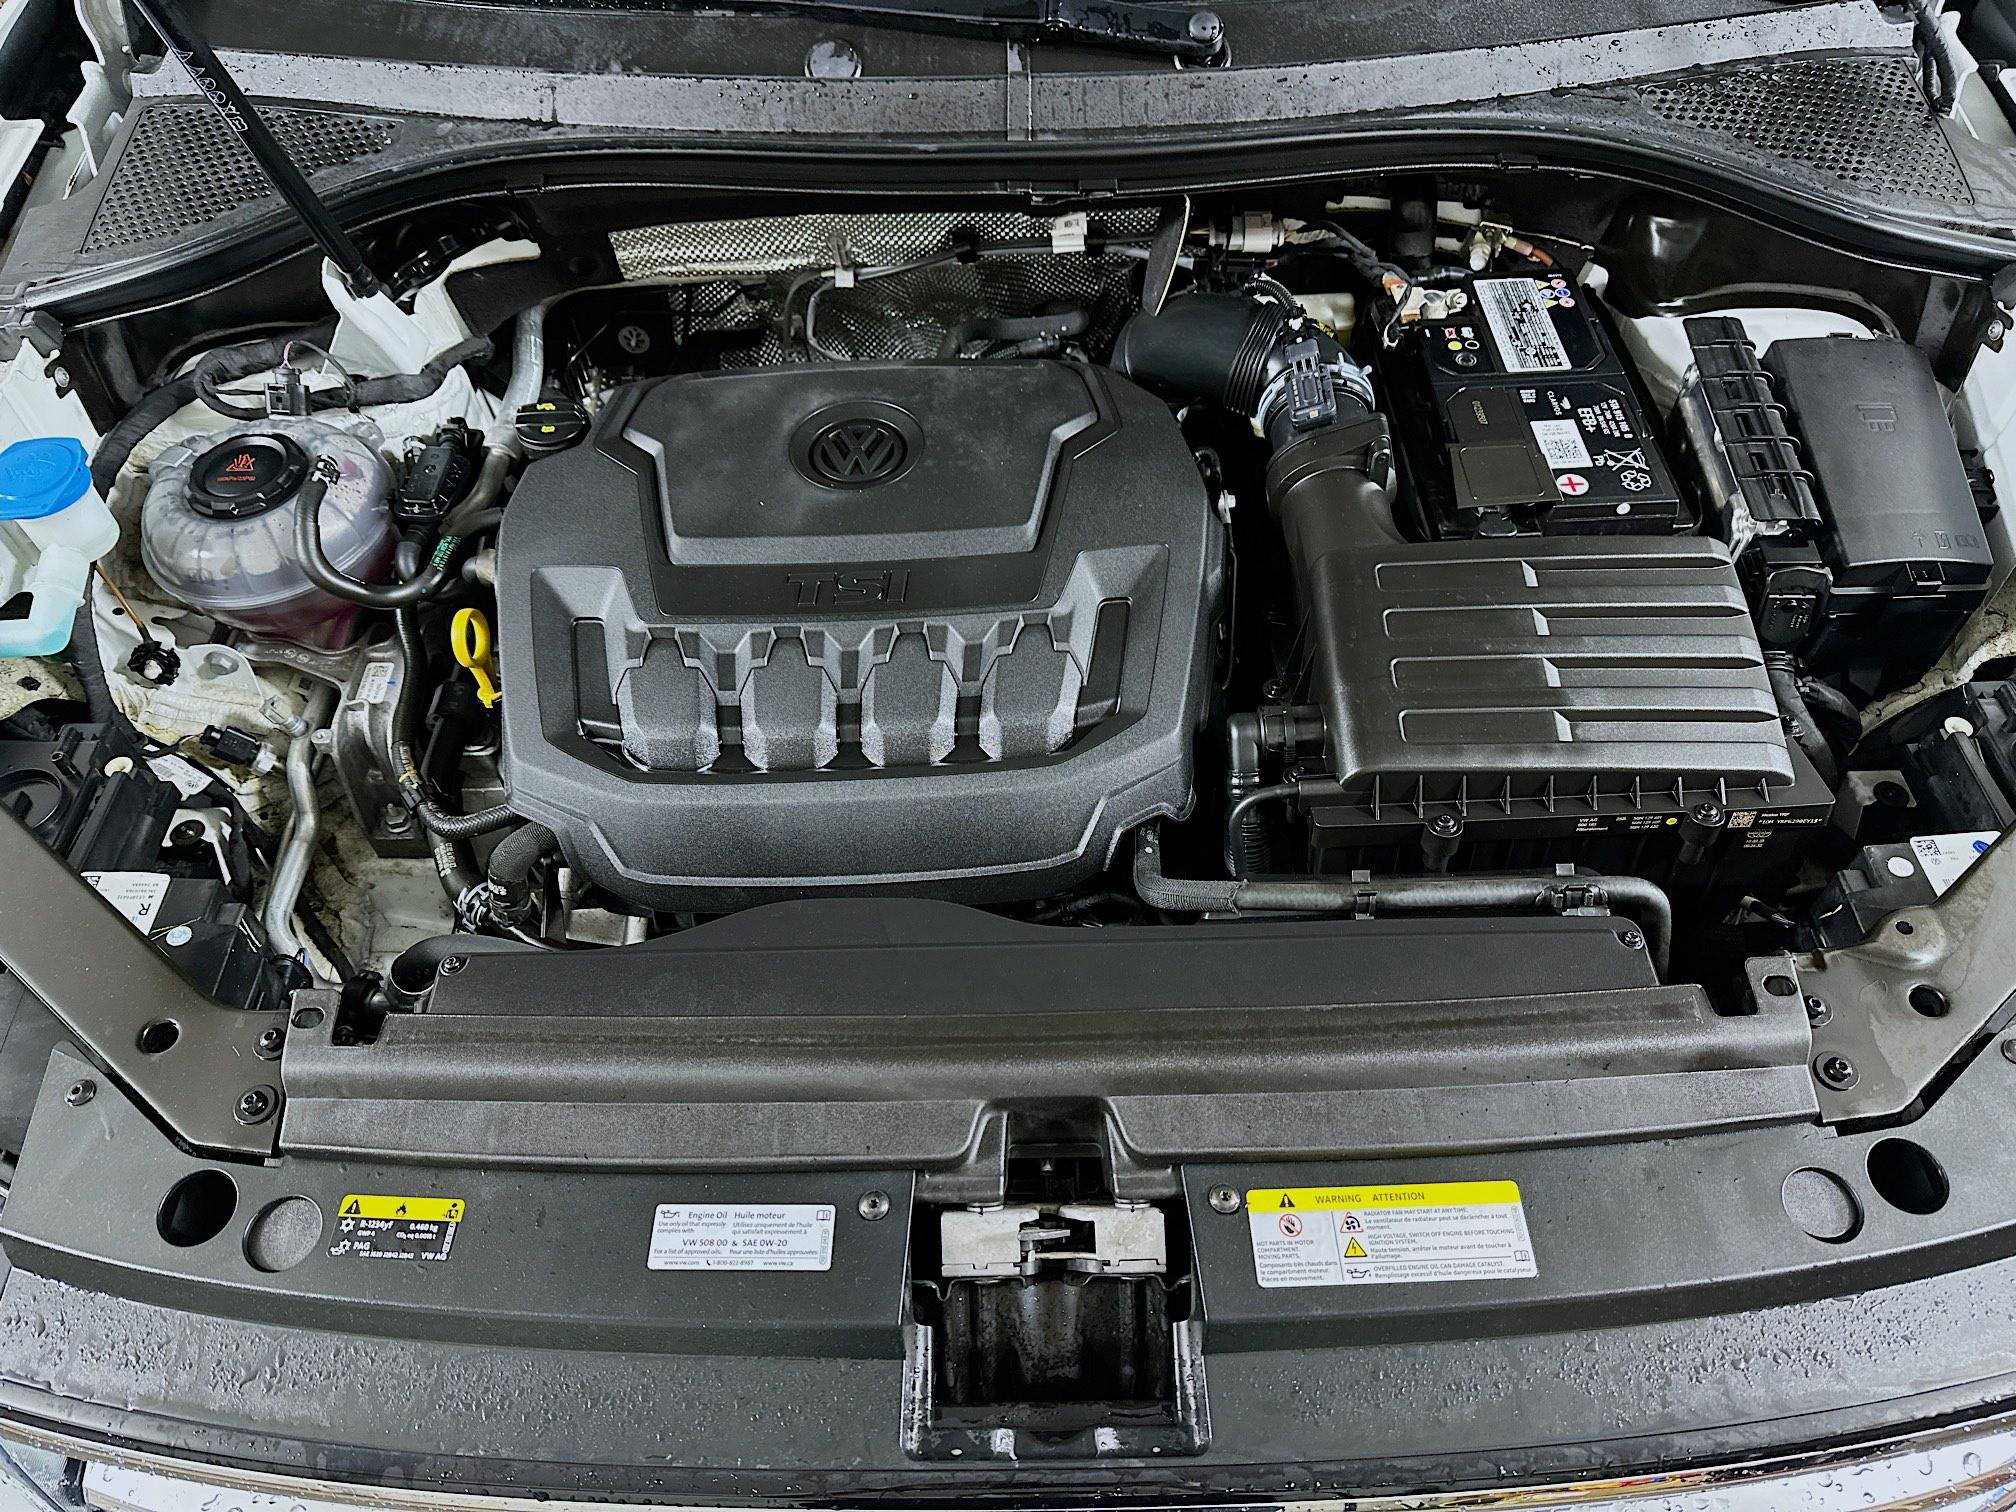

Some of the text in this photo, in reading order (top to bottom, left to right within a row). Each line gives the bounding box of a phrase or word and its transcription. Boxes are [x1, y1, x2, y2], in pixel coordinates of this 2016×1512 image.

[1546, 390, 1562, 416] CLARIOS
[1578, 408, 1598, 432] EFB+
[1592, 454, 1606, 466] Pb
[787, 569, 911, 607] TSI
[138, 903, 151, 916] R
[1315, 1192, 1424, 1204] WARNING ATTENTION
[688, 1212, 714, 1221] Engine
[360, 1220, 394, 1231] R-1234yf
[430, 1224, 439, 1233] kg
[353, 1242, 370, 1250] PAG
